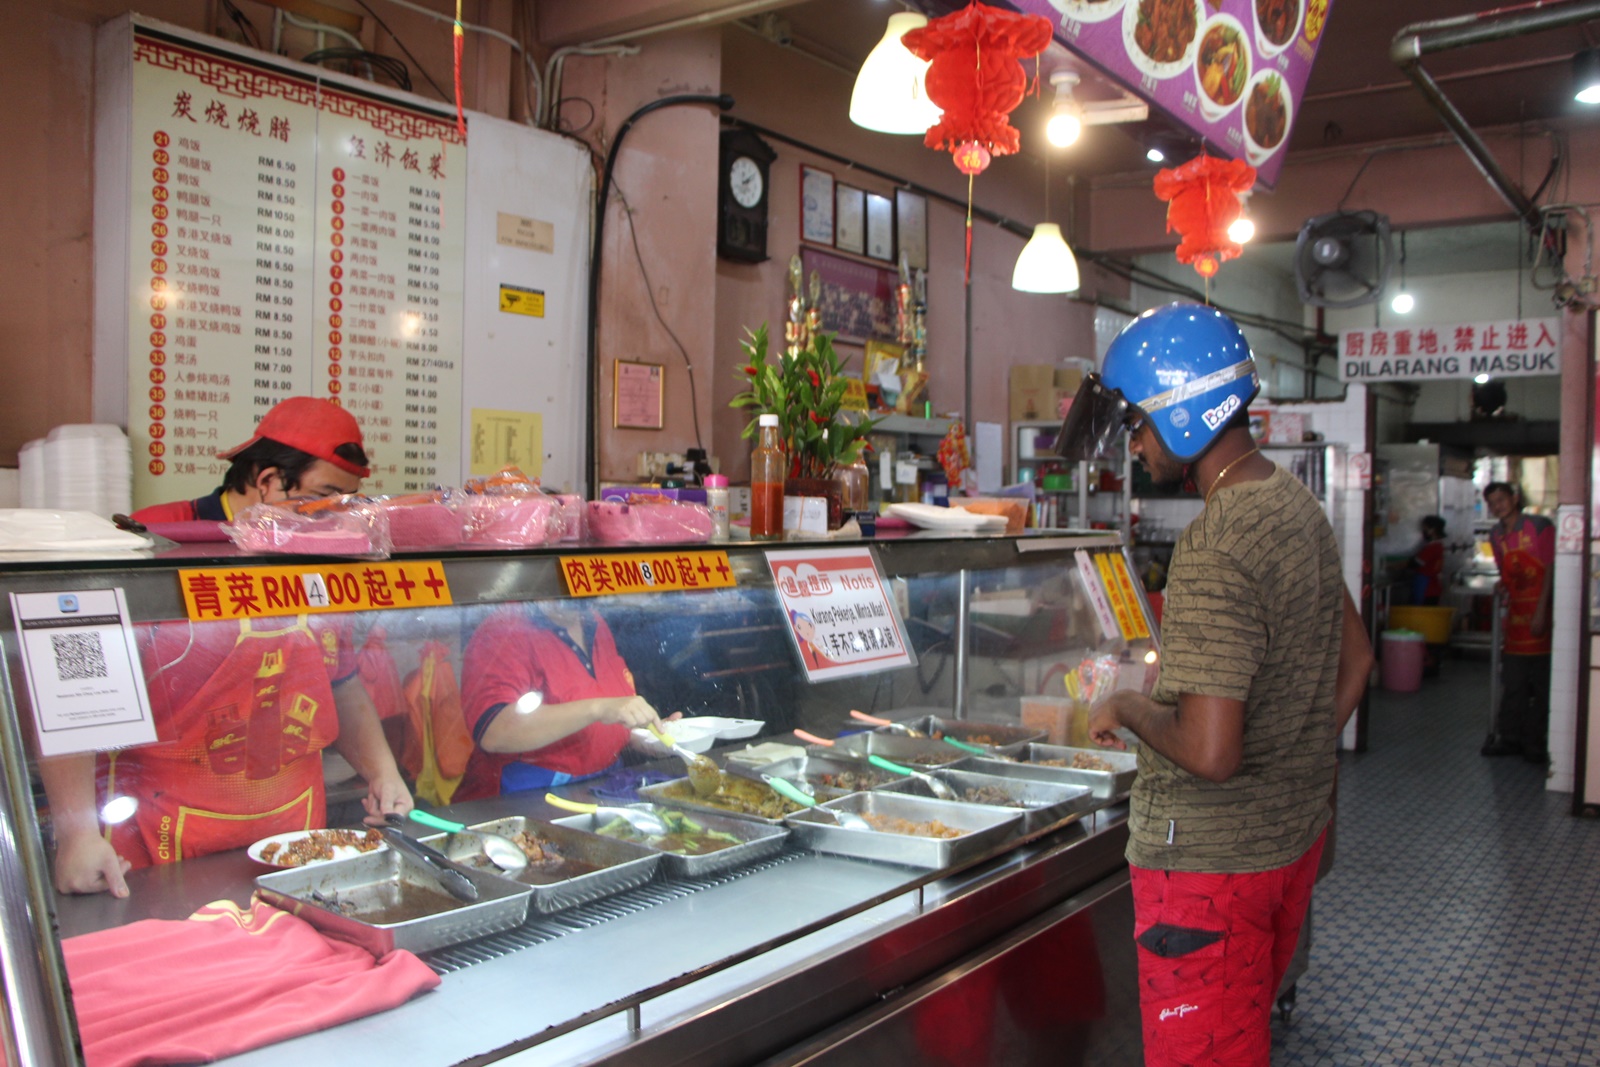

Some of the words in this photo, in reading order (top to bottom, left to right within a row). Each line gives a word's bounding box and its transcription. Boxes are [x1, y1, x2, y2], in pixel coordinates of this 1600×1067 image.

[171, 90, 291, 143] 炭烧烧腊
[155, 132, 168, 146] 21
[258, 155, 273, 167] RM
[155, 151, 168, 164] 22
[257, 173, 273, 184] RM
[154, 169, 168, 182] 23
[257, 190, 272, 201] RM
[409, 186, 422, 196] RM
[154, 187, 167, 201] 24
[257, 207, 272, 218] RM
[409, 201, 422, 211] RM
[154, 206, 167, 219] 25
[256, 223, 272, 235] RM
[409, 216, 421, 227] RM
[153, 224, 167, 237] 26
[256, 241, 271, 252] RM
[408, 232, 421, 242] RM
[153, 242, 166, 255] 27
[177, 245, 208, 259] 叉烧饭
[256, 258, 271, 269] RM
[408, 248, 421, 257] RM
[408, 263, 420, 272] RM
[153, 261, 166, 273] 28
[177, 263, 219, 278] 叉烧鸡饭
[255, 275, 271, 286] RM
[407, 279, 420, 288] RM
[255, 292, 270, 303] RM
[407, 294, 420, 303] RM
[255, 310, 270, 320] RM
[152, 316, 165, 328] 31
[254, 327, 270, 337] RM
[152, 334, 165, 346] 32
[254, 344, 269, 354] RM
[406, 342, 419, 351] RM
[151, 352, 164, 364] 33
[254, 362, 269, 371] RM
[406, 357, 419, 366] RM
[1345, 357, 1460, 378] DILARANG
[1470, 352, 1556, 373] MASUK
[151, 371, 164, 383] 34
[254, 379, 269, 388] RM
[406, 373, 419, 381] RM
[151, 389, 164, 401] 35
[254, 396, 269, 405] RM
[405, 388, 418, 397] RM
[150, 408, 163, 419] 36
[405, 404, 418, 412] RM
[405, 419, 418, 428] RM
[150, 426, 163, 437] 37
[405, 435, 418, 443] RM
[421, 436, 436, 445] 1.50
[150, 444, 163, 456] 38
[172, 443, 223, 457] 香港叉烧一
[405, 451, 417, 459] RM
[420, 451, 436, 460] 1.50
[149, 463, 163, 474] 39
[404, 466, 417, 475] RM
[404, 482, 417, 490] RM
[840, 573, 875, 591] Notis
[810, 608, 836, 627] Kurang
[854, 602, 871, 620] Minta
[159, 815, 171, 860] Choice
